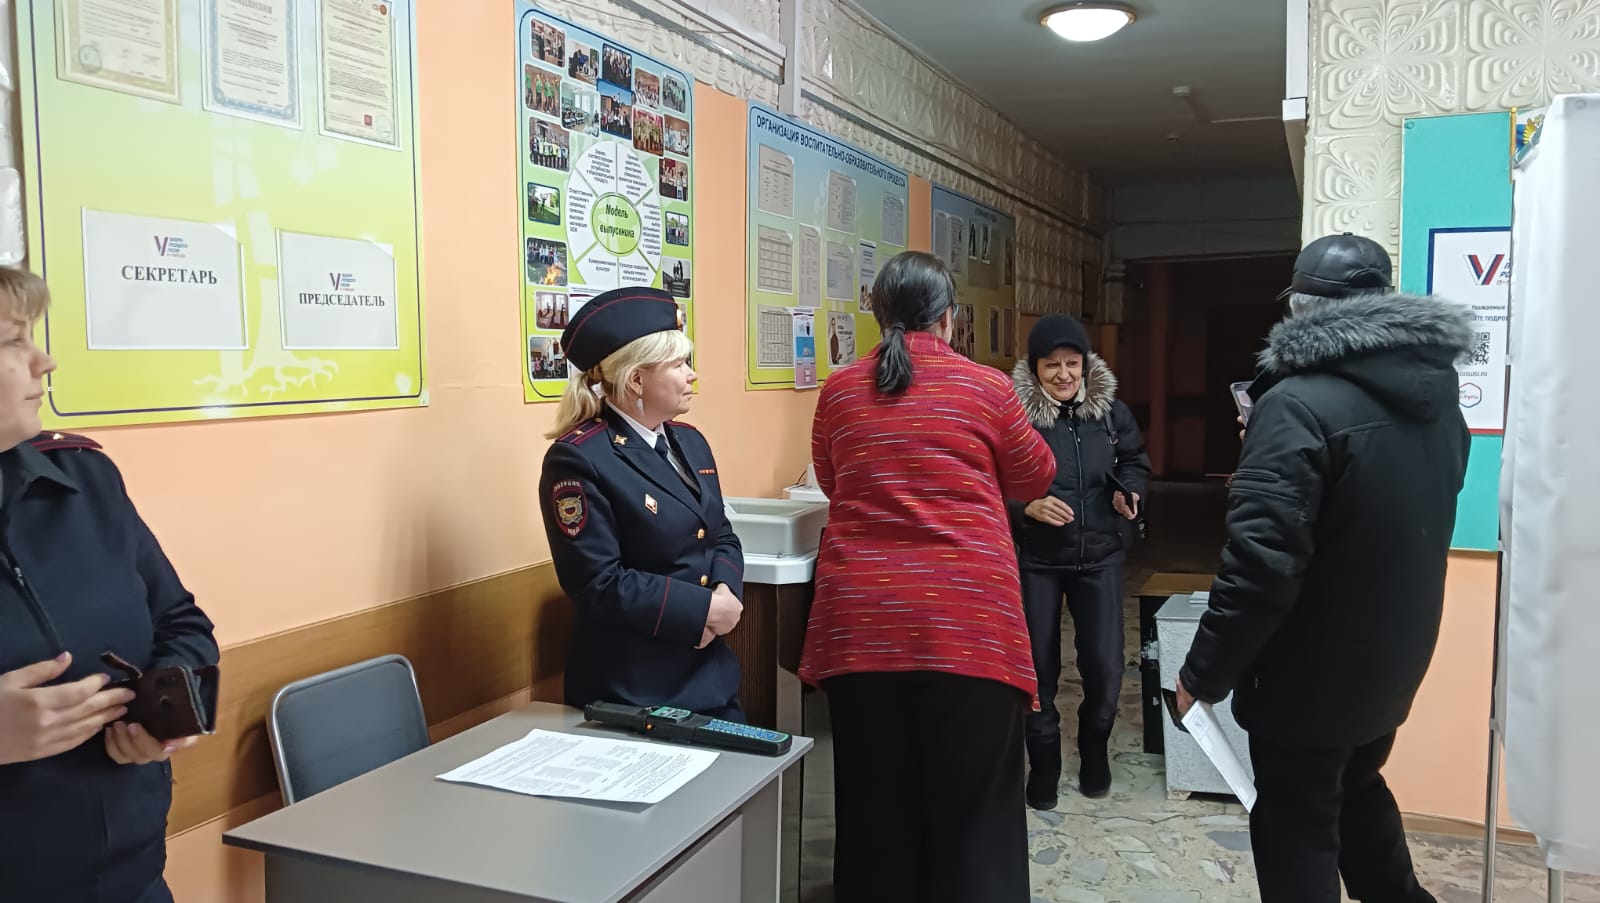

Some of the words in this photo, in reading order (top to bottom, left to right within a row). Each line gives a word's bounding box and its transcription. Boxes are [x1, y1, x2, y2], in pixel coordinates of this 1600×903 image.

[756, 115, 799, 141] ОРГАНИЗАЦИЯ
[800, 133, 887, 179] ВОСПИТАТЕЛЬНО-ОБРАЗОВАТЕЛЬНОГО
[887, 171, 906, 188] ПРОЦЕССА
[605, 204, 629, 219] Модель
[600, 224, 635, 238] выпускника
[121, 264, 217, 285] СЕКРЕТАРЬ
[299, 293, 385, 307] ПРЕДСЕДАТЕЛЬ
